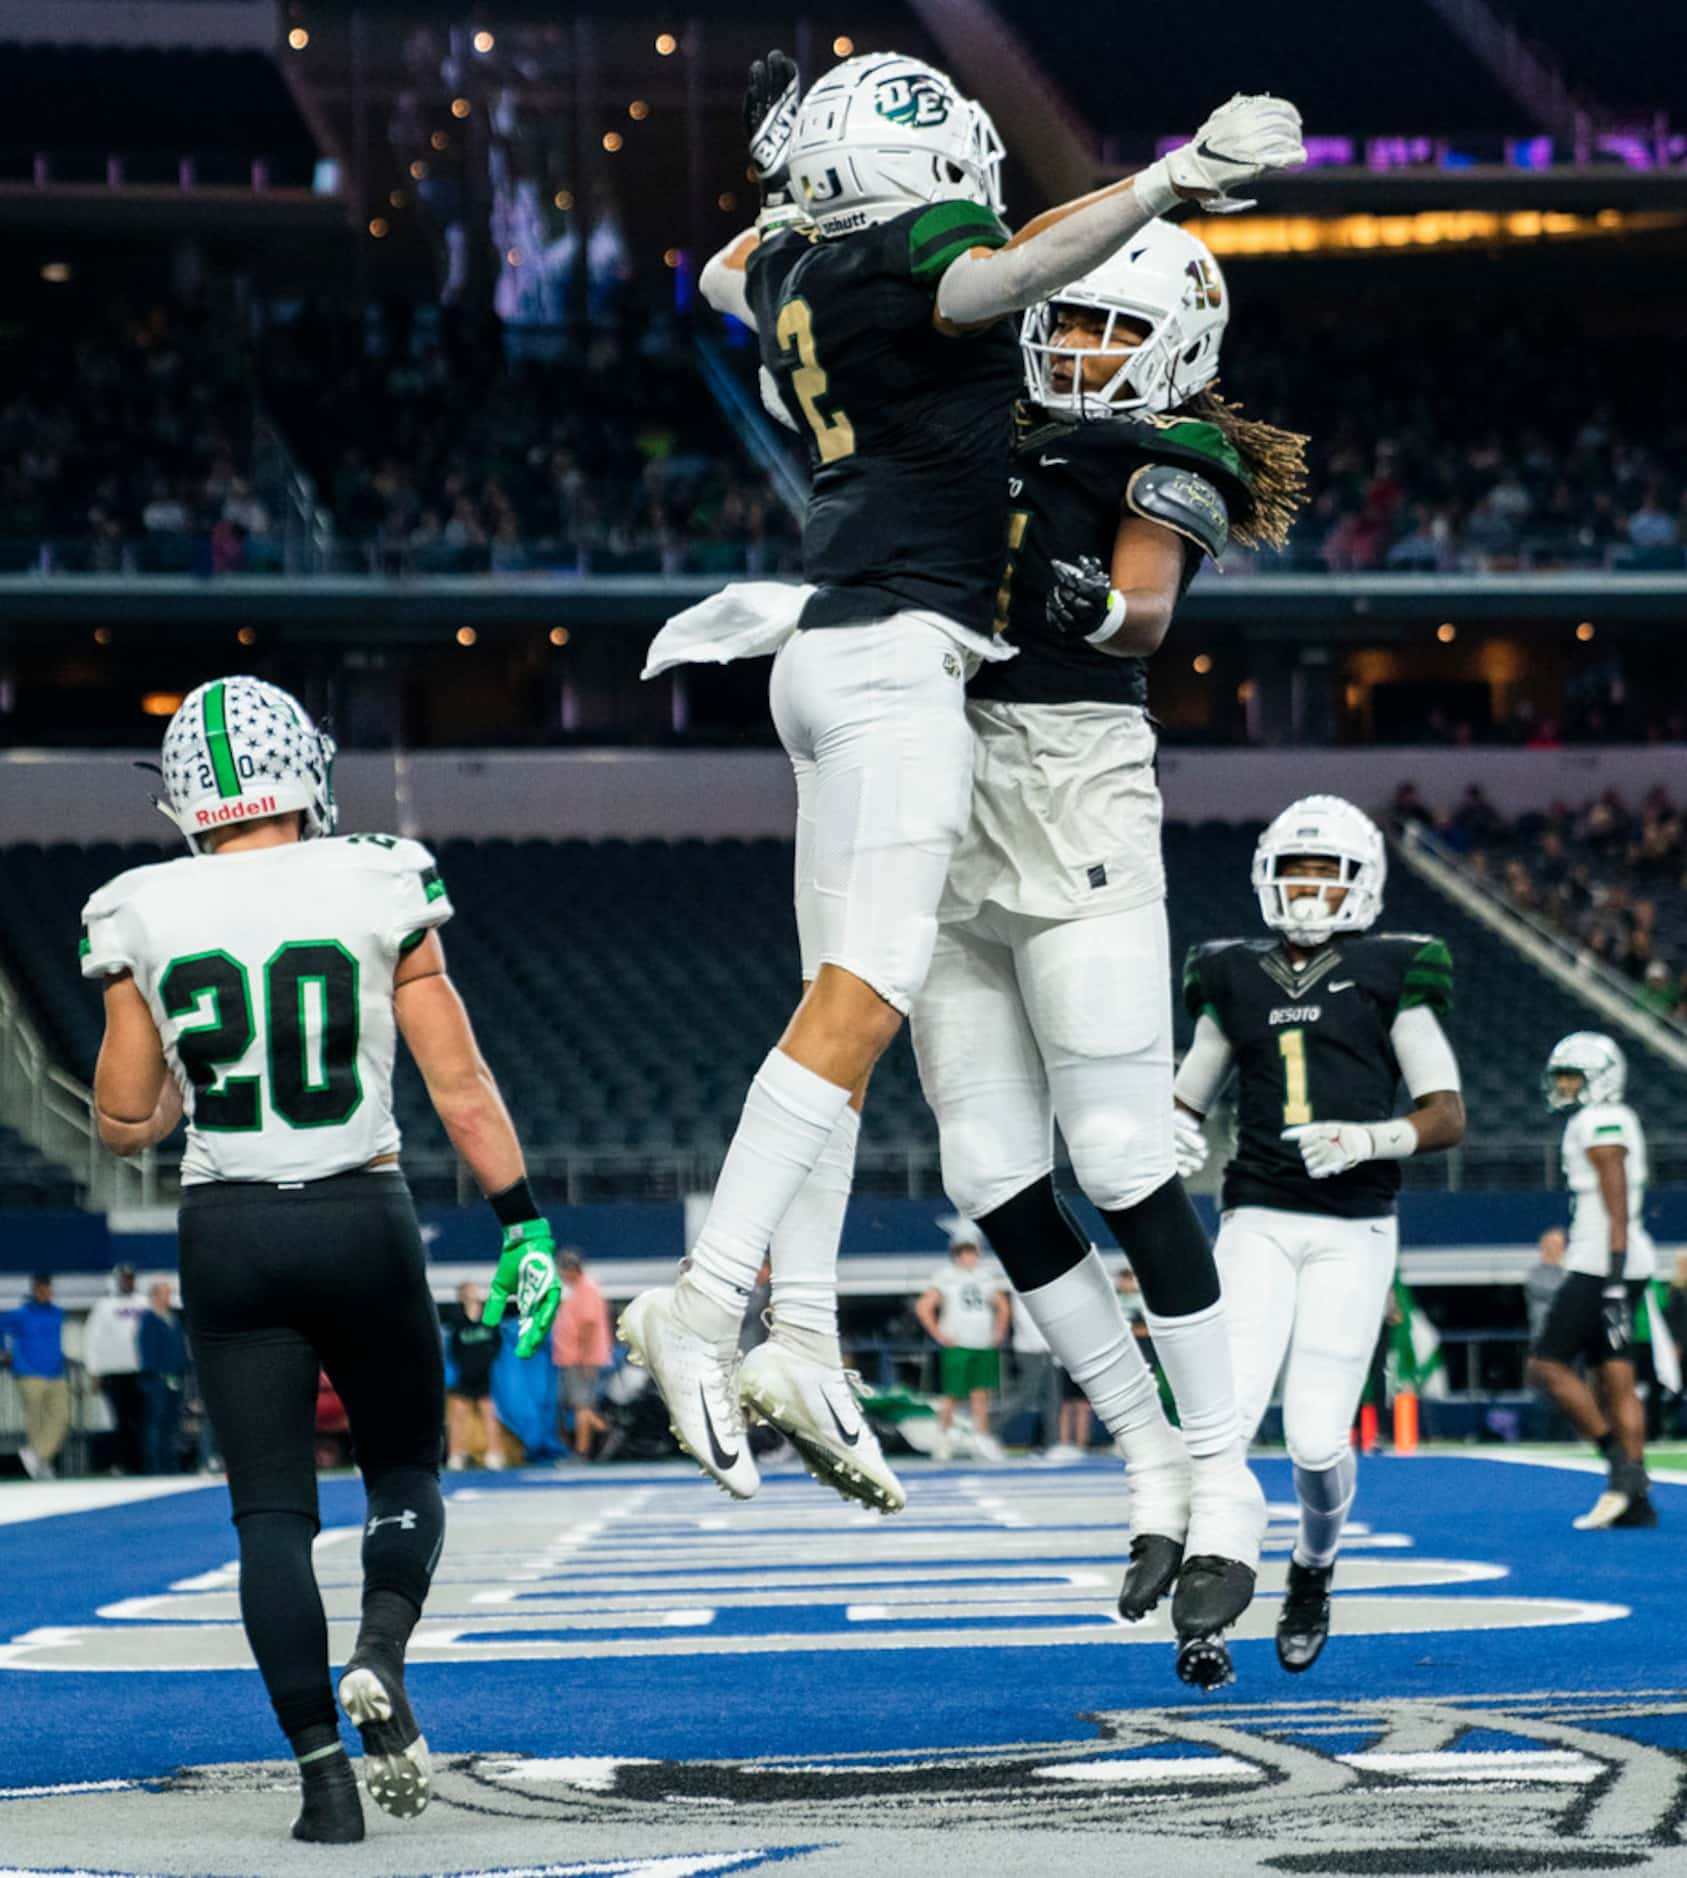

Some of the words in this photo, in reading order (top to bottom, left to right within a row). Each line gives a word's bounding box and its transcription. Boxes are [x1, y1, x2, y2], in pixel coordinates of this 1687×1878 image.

[1184, 259, 1222, 311] 15
[775, 297, 855, 464] 2
[195, 796, 277, 826] Riddell
[158, 938, 364, 1132] 20
[1268, 1005, 1321, 1026] DESOTO
[1278, 1027, 1313, 1126] 1
